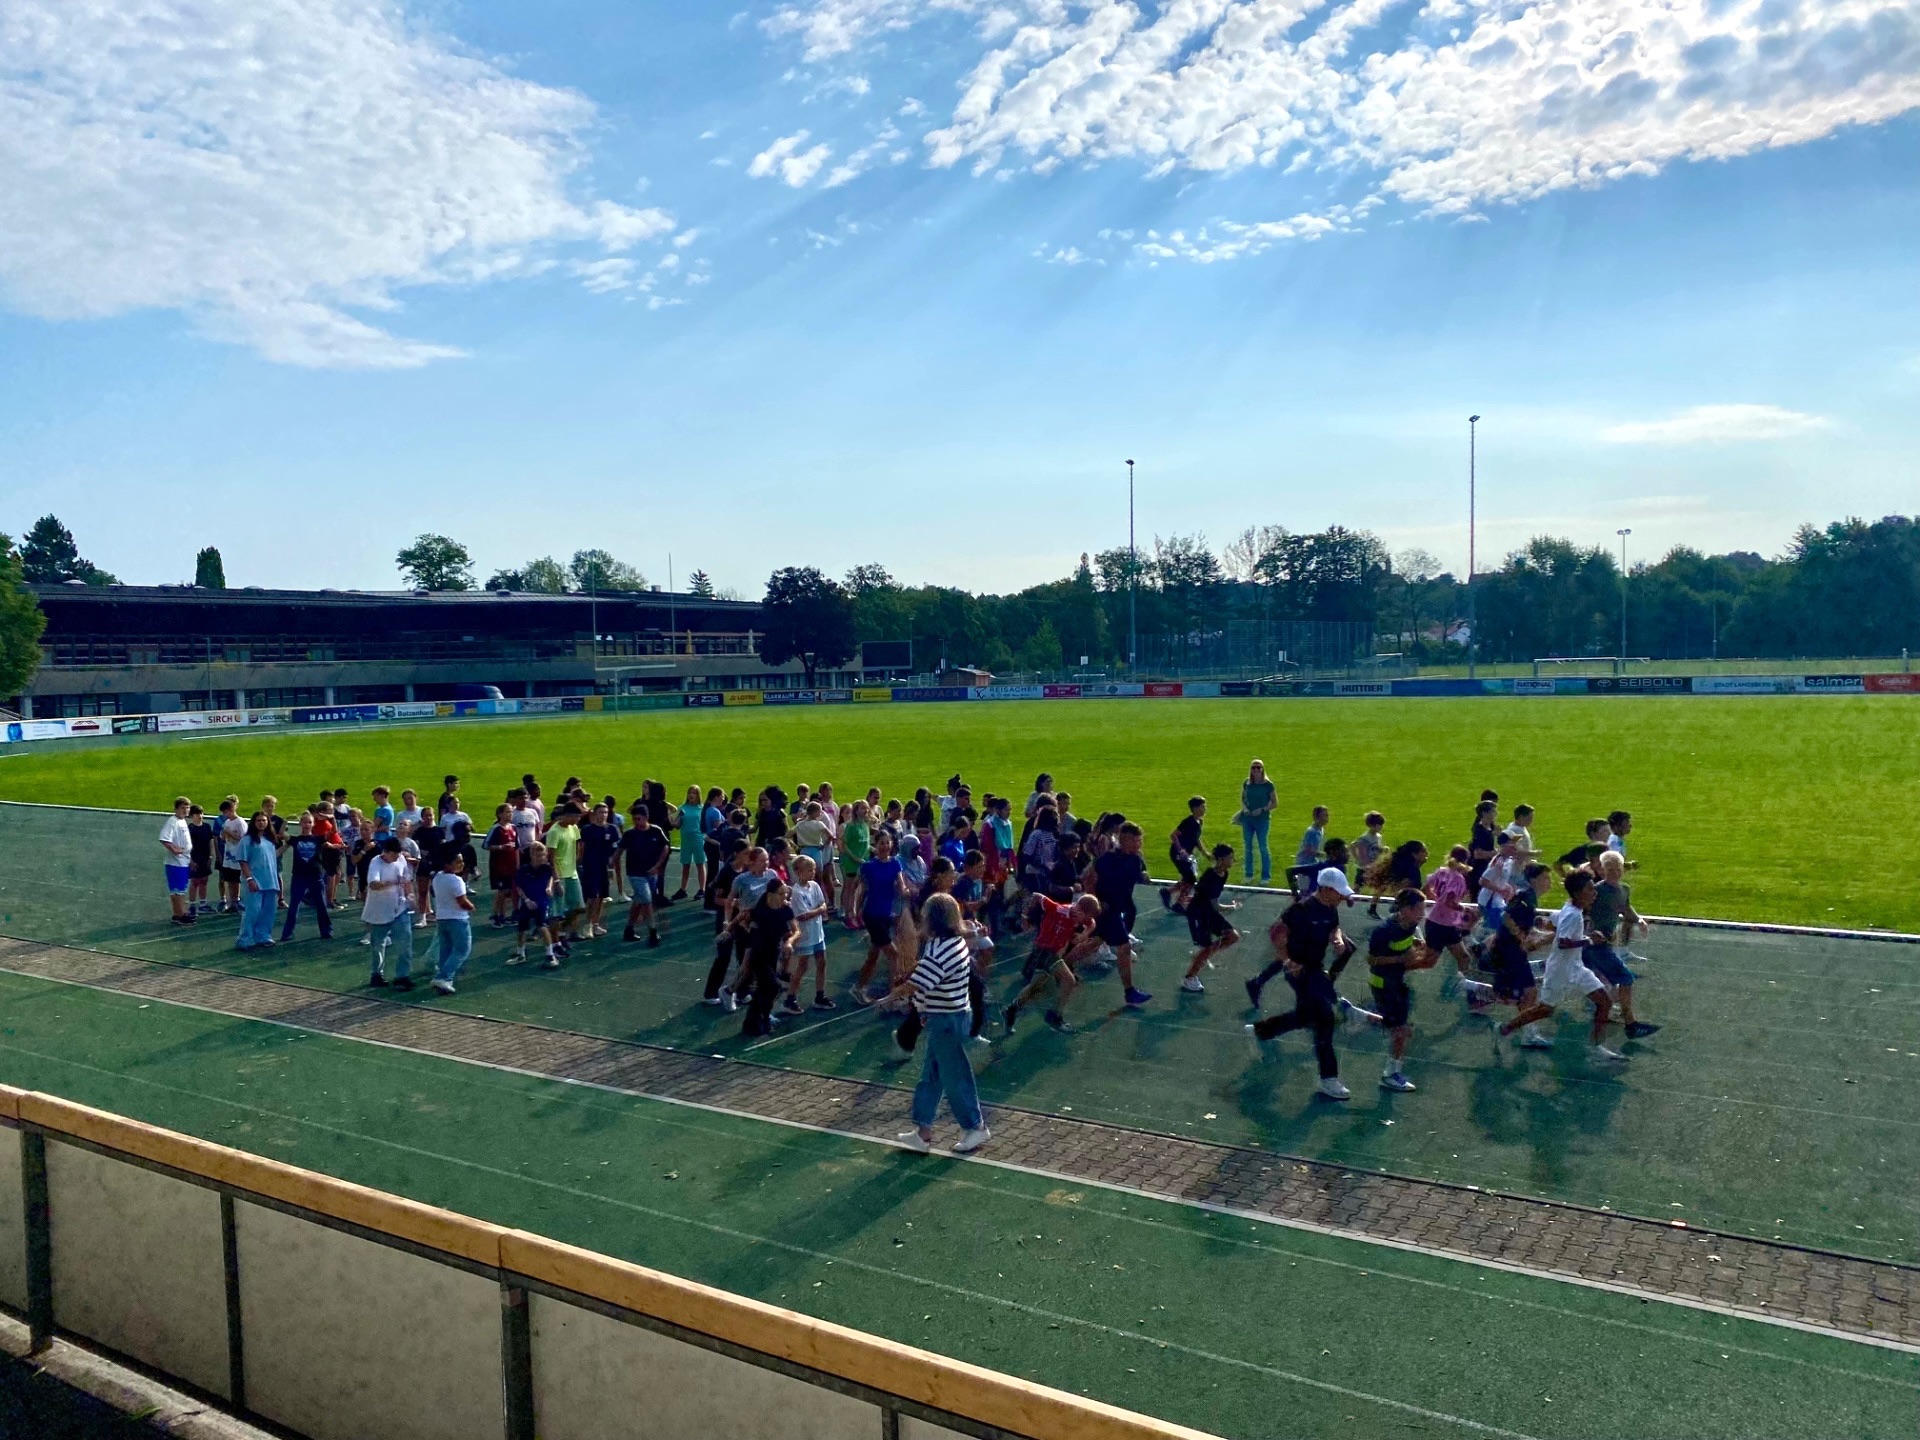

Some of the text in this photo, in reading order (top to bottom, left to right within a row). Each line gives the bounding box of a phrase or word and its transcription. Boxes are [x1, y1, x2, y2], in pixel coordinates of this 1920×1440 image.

[1619, 678, 1683, 686] SEIBOLD
[899, 690, 960, 698] KEMAPACK
[309, 712, 346, 721] HARDY
[397, 709, 434, 717] Botzenhard
[208, 715, 233, 723] SIRCH
